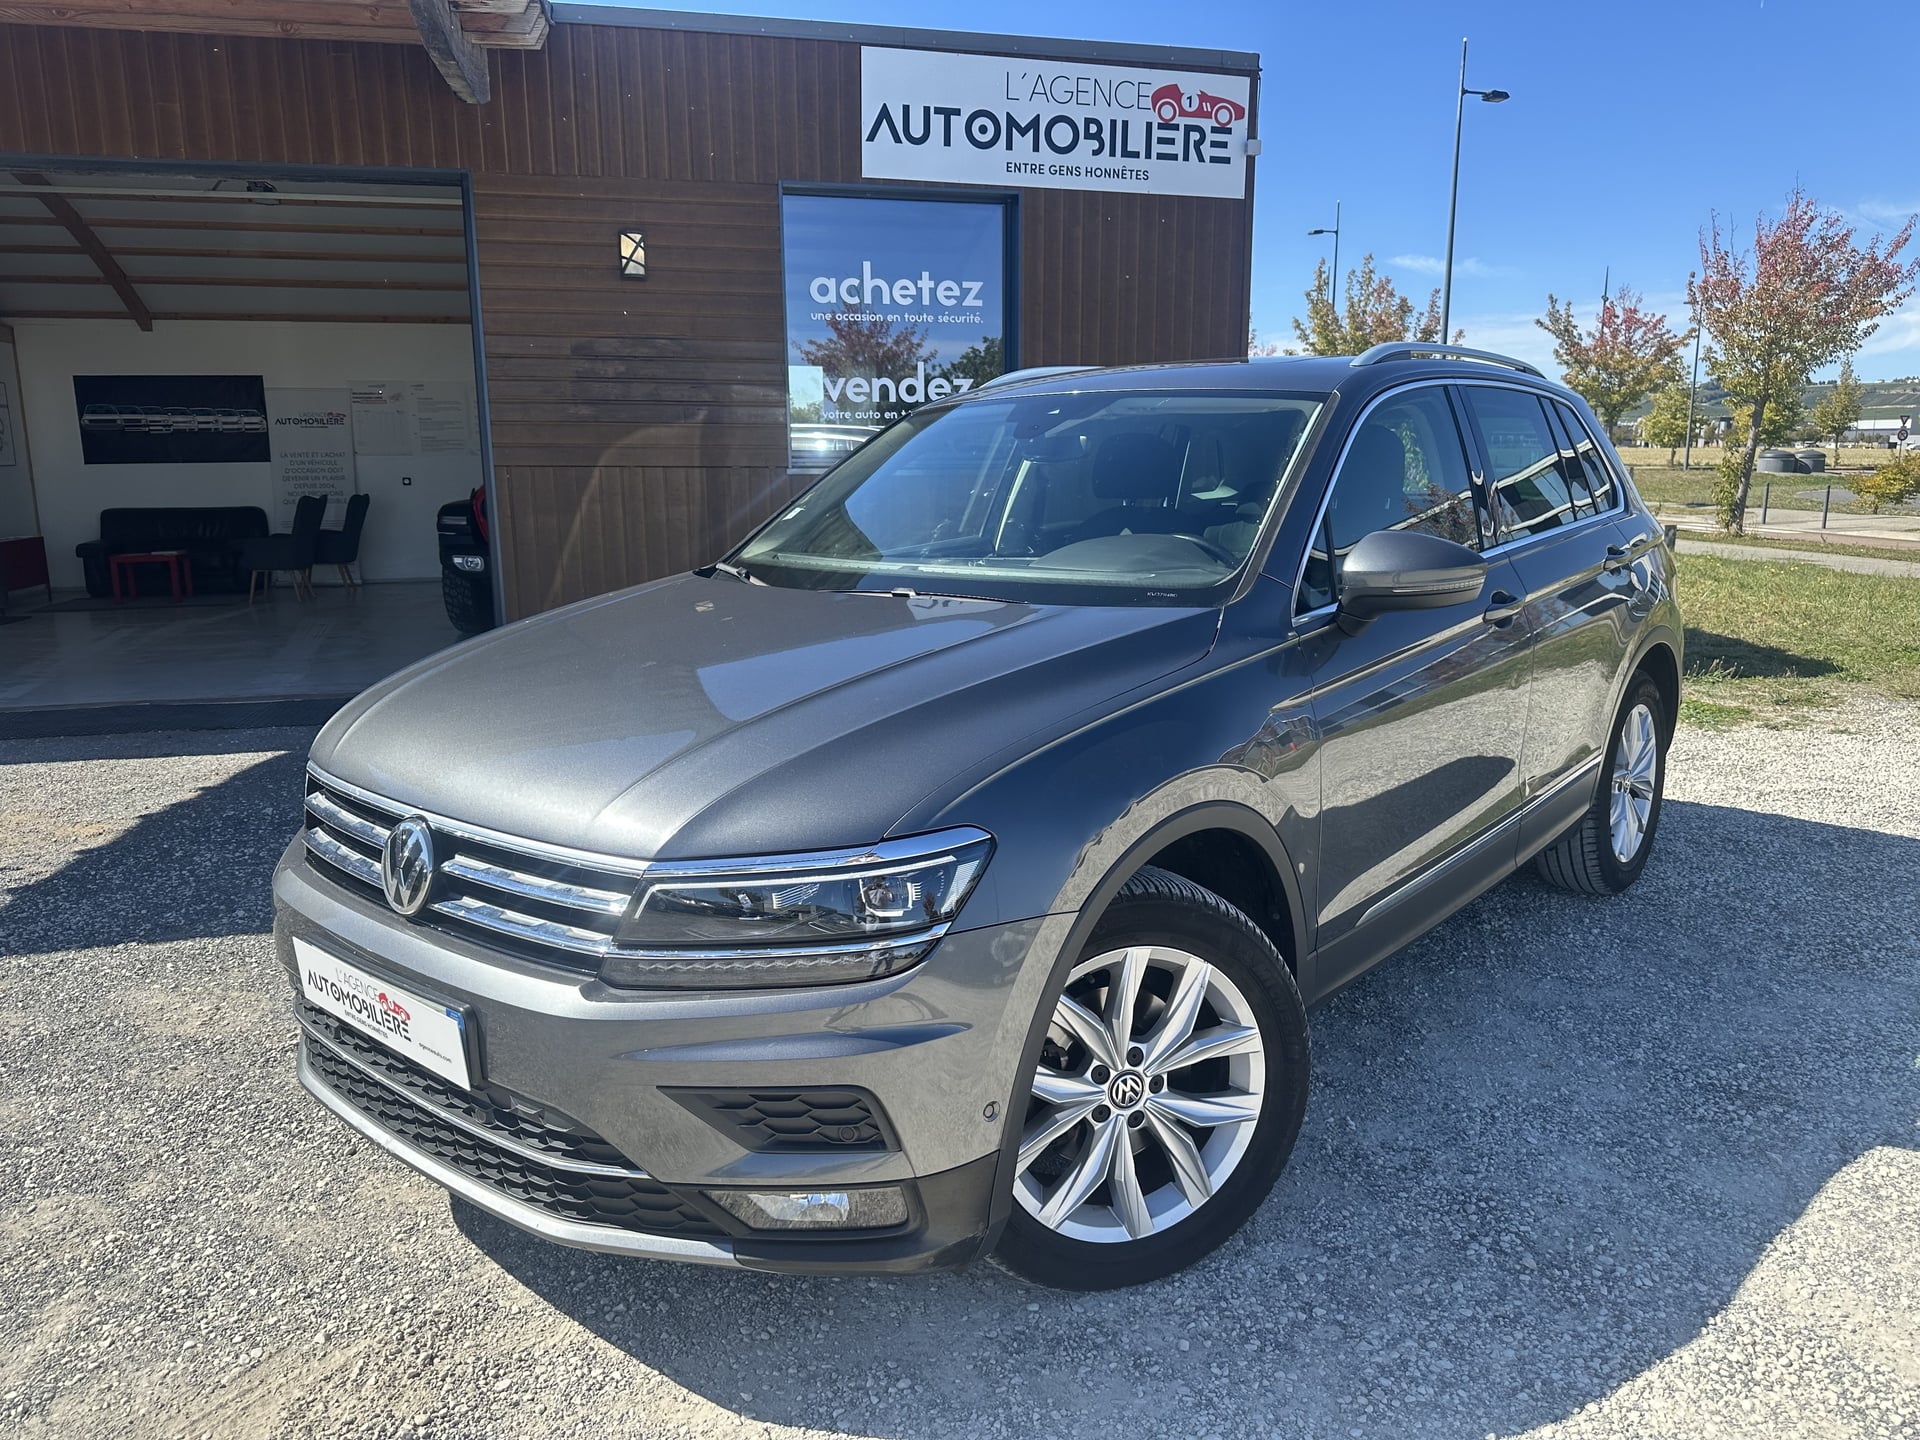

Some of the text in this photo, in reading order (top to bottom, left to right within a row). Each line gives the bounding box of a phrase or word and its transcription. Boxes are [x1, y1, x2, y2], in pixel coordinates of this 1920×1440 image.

[1005, 71, 1153, 111] L'AGENCE
[1006, 161, 1150, 181] ENTRE GENS HONNÊTES
[809, 261, 984, 307] achetez
[810, 310, 984, 324] une occasion en toute sécurité.
[823, 361, 974, 404] vendez
[823, 409, 852, 419] votre
[855, 409, 881, 419] auto
[884, 411, 898, 419] en
